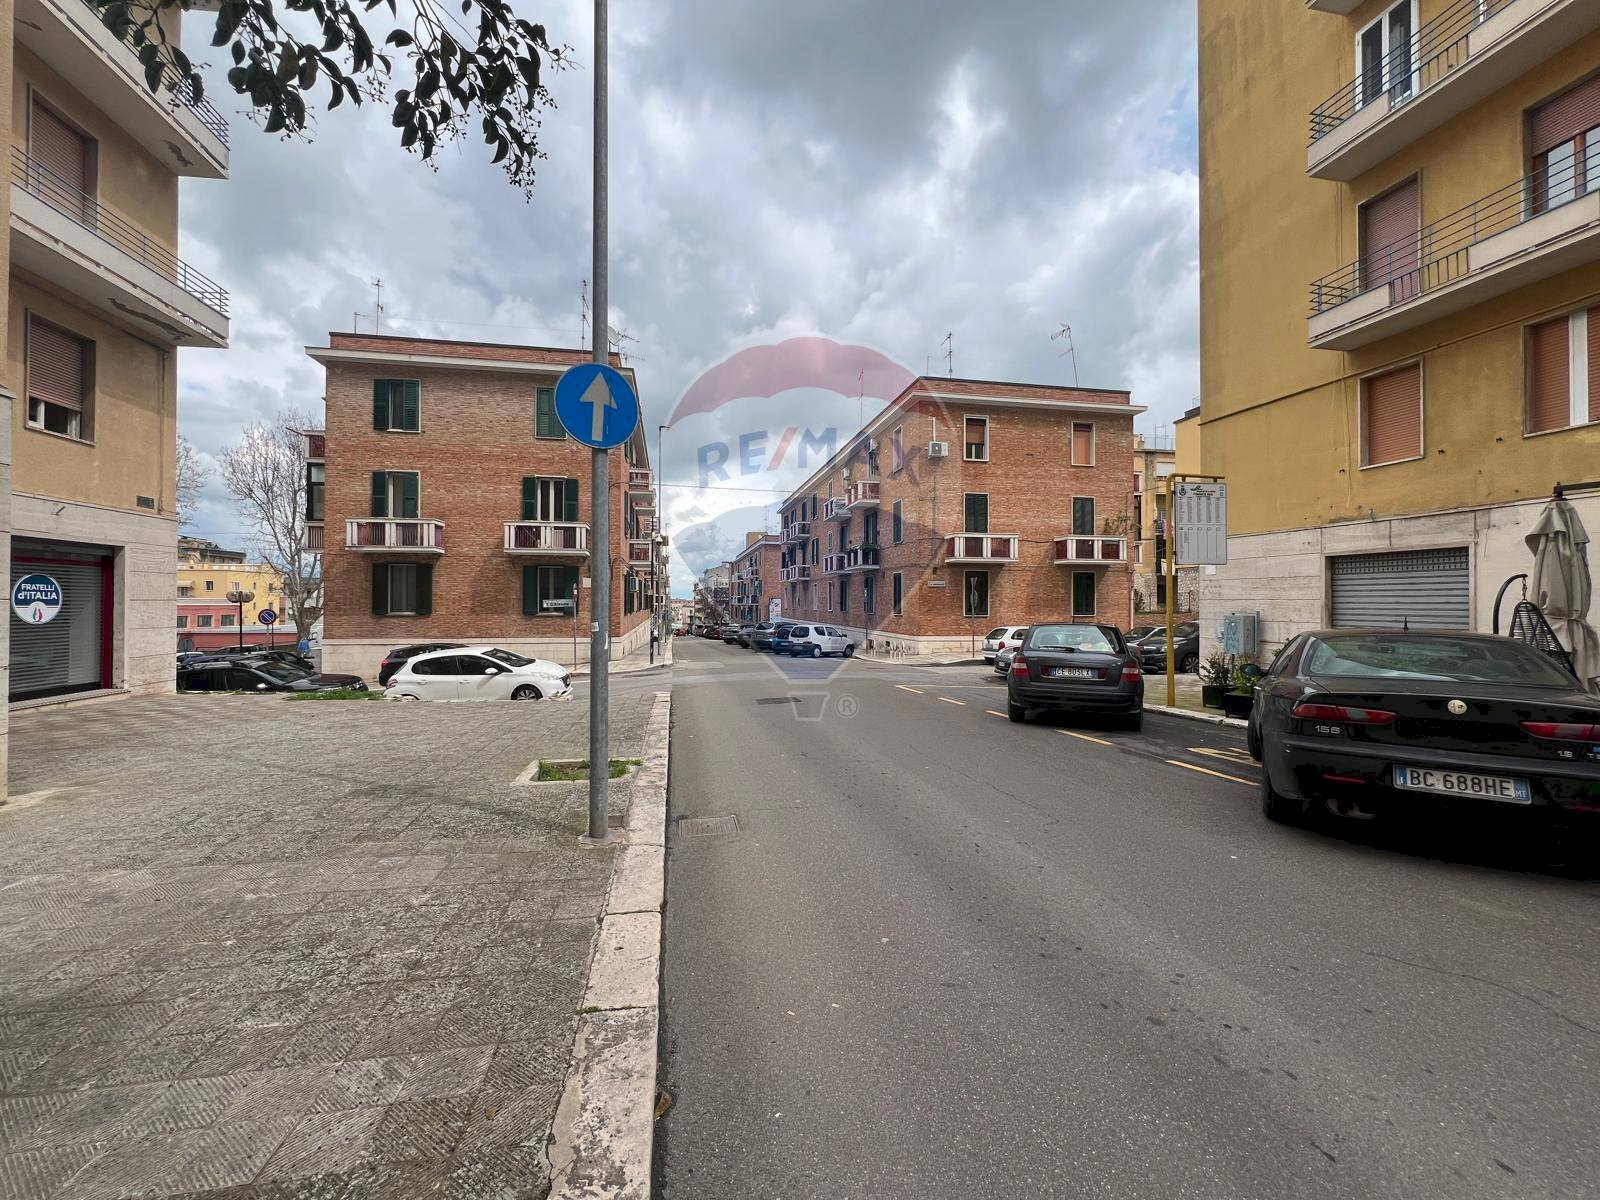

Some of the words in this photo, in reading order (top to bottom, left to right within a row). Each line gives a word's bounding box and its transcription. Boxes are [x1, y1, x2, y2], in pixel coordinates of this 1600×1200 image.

[21, 583, 55, 591] FRATELLI
[17, 591, 58, 600] d'ITALIA
[1314, 724, 1341, 734] 156
[1409, 769, 1435, 788] BC
[1442, 773, 1513, 798] 688HE
